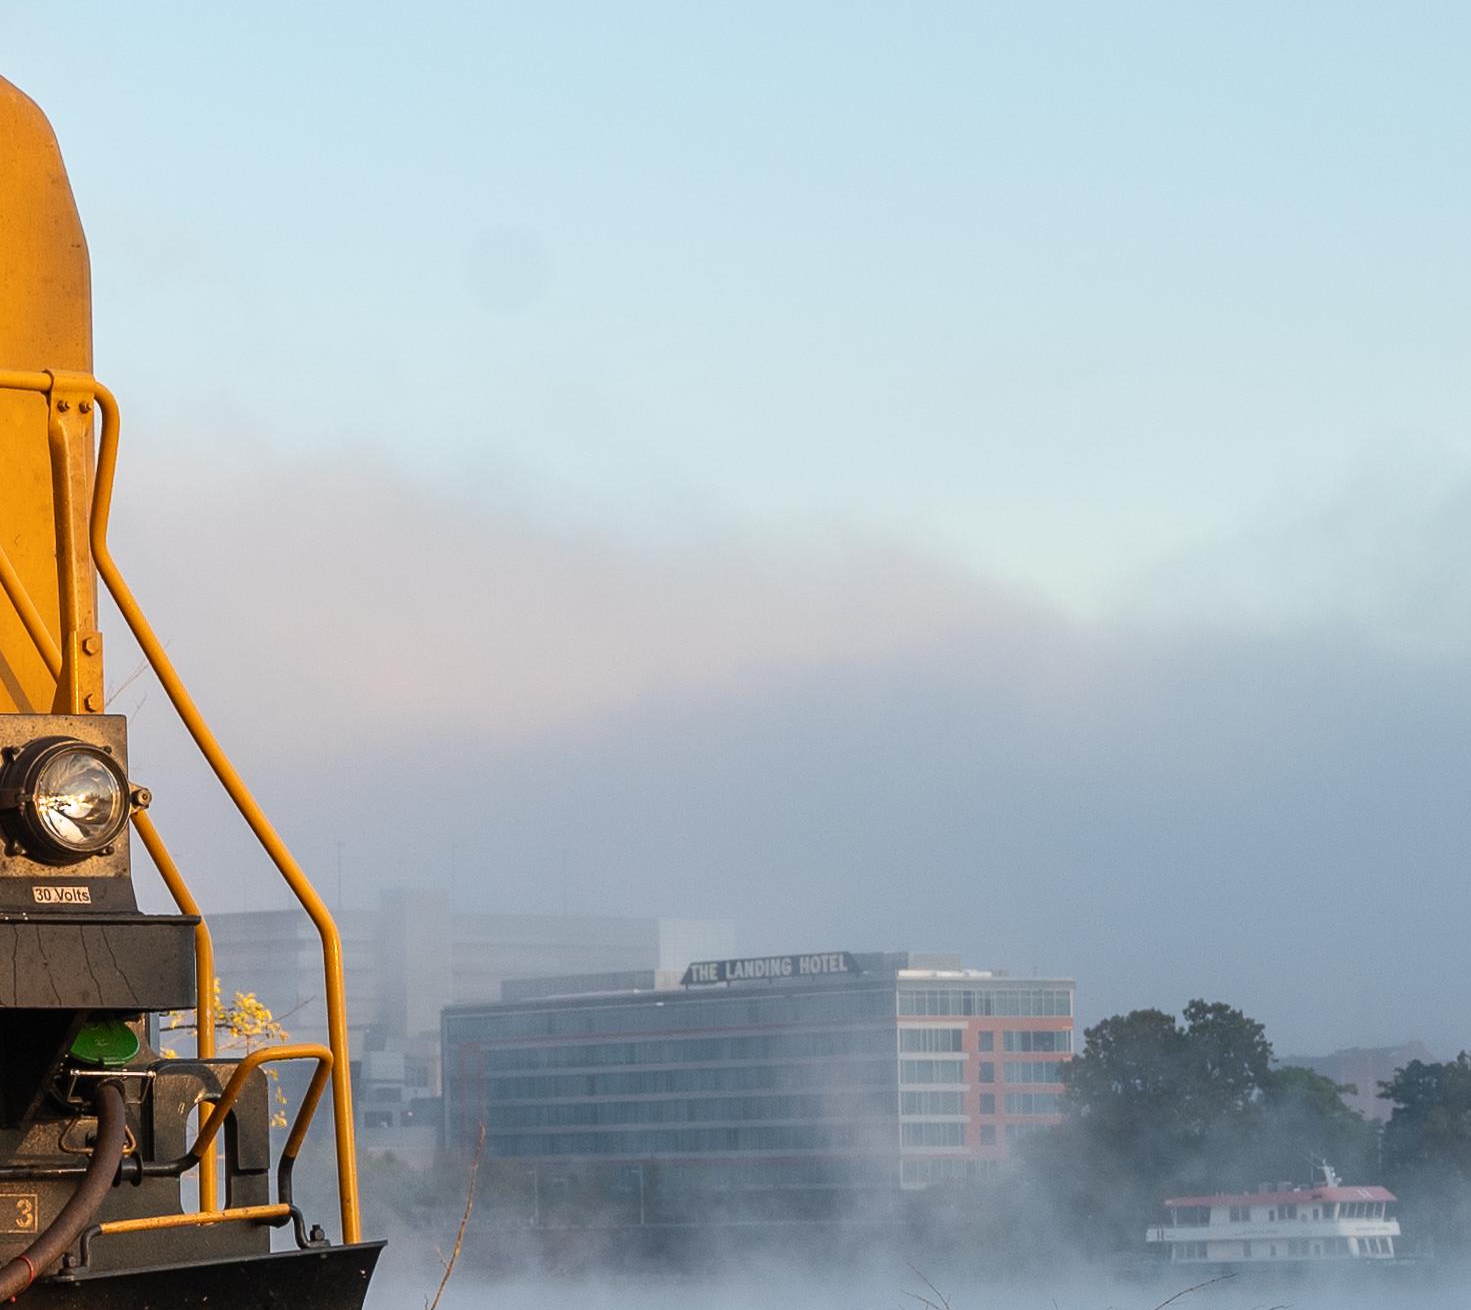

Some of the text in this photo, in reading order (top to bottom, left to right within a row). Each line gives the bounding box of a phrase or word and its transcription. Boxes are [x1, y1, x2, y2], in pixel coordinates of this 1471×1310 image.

[34, 888, 90, 902] 30 Volts
[691, 953, 849, 982] THE LANDING HOTEL
[16, 1199, 33, 1228] 3
